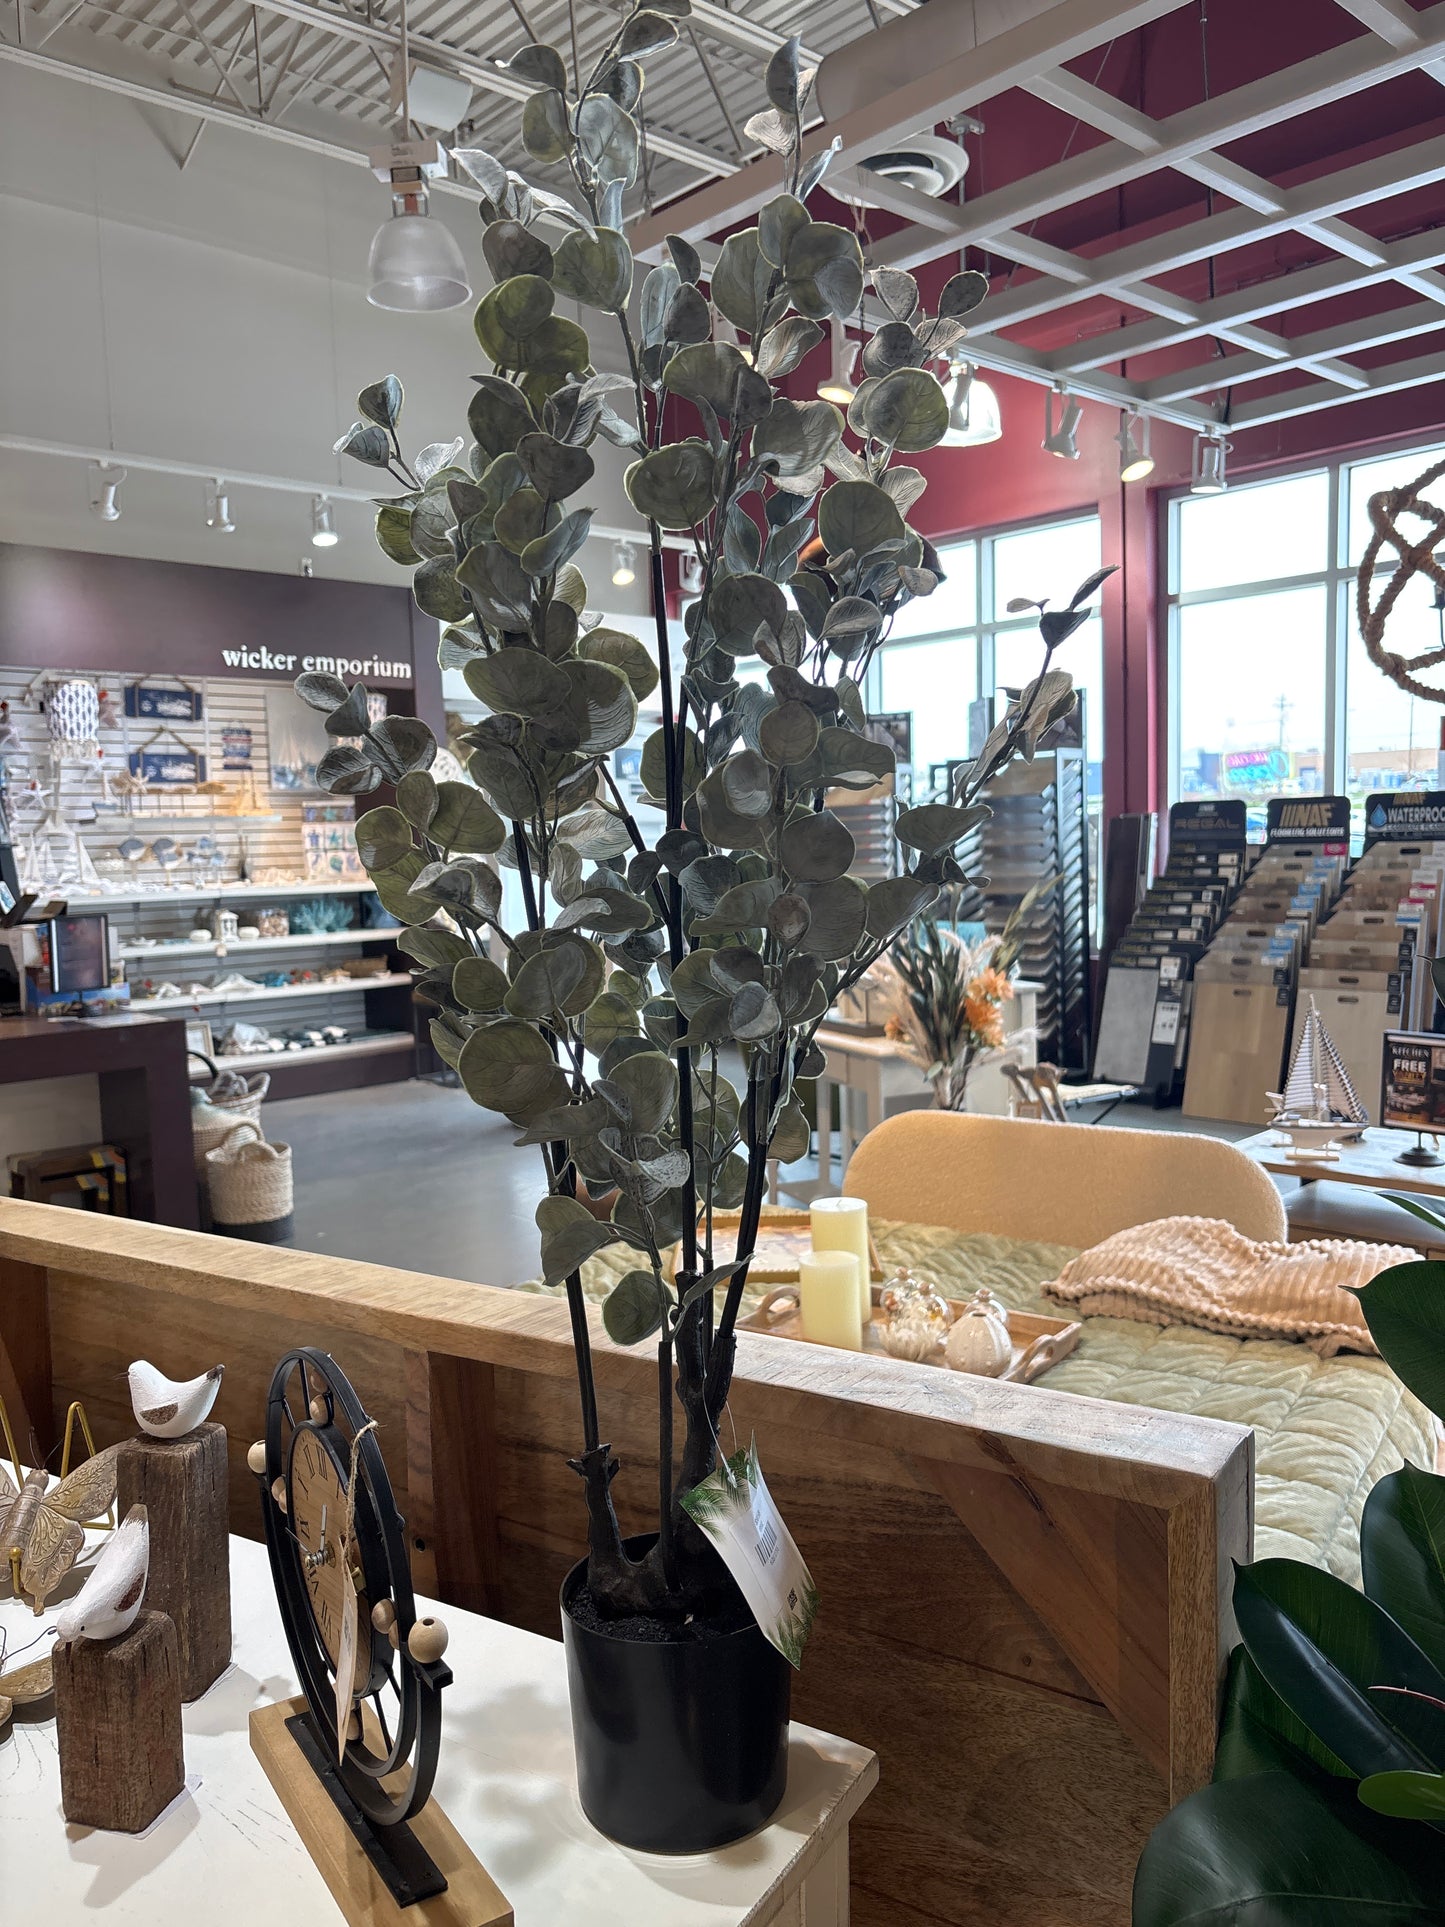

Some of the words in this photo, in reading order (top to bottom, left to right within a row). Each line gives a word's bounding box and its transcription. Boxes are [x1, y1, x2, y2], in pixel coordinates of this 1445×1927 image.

[221, 644, 298, 671] wicker
[302, 654, 412, 680] emporium
[1174, 818, 1240, 829] REGAL
[1392, 1046, 1430, 1058] KITCHEN
[1393, 1058, 1427, 1073] FREE
